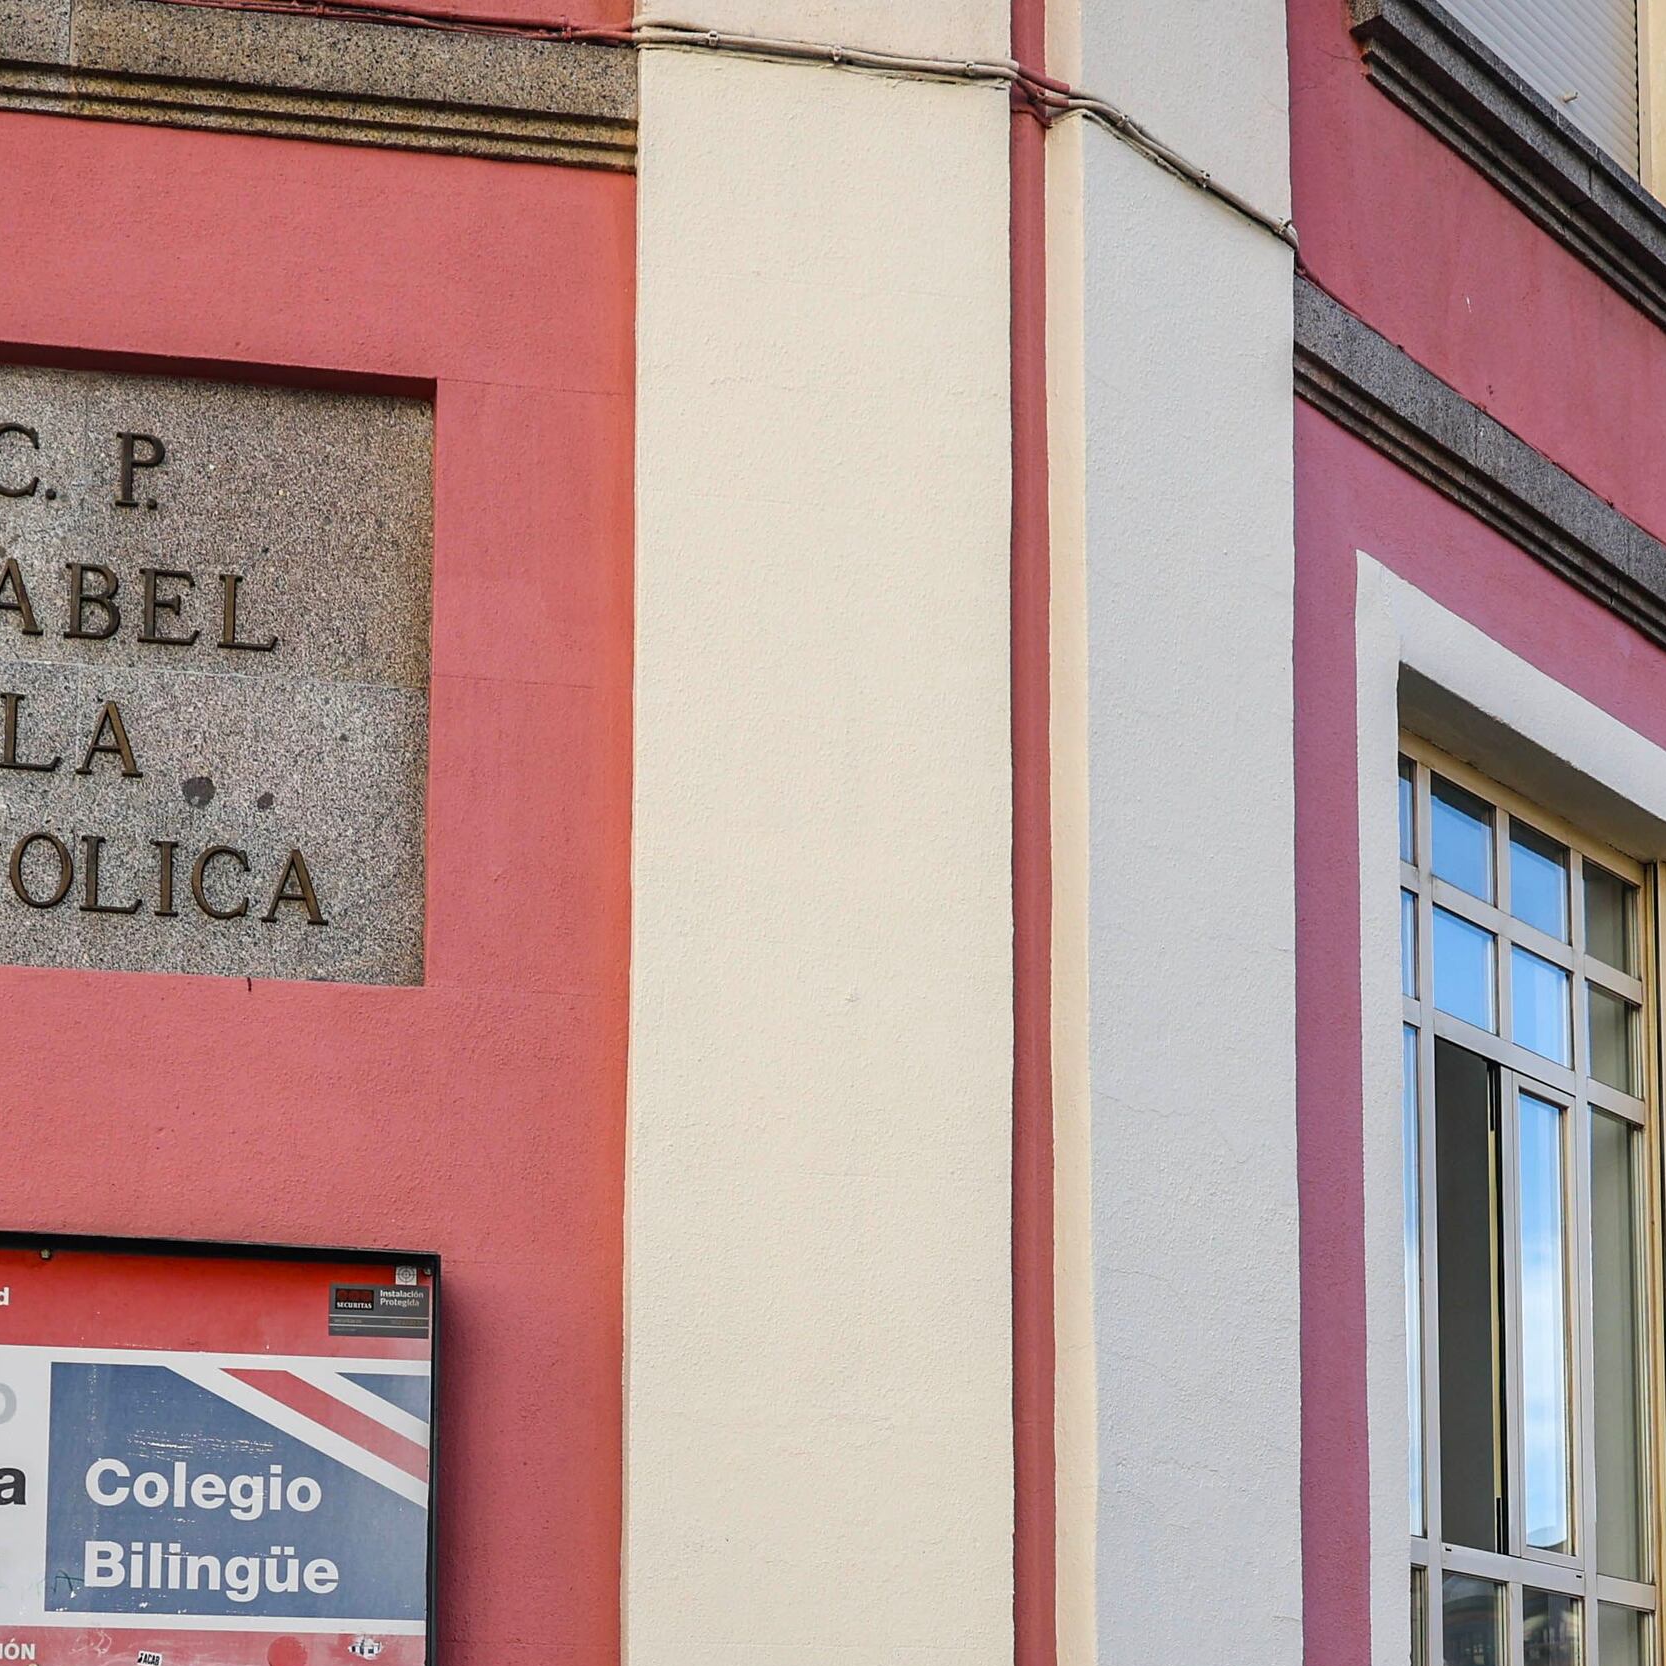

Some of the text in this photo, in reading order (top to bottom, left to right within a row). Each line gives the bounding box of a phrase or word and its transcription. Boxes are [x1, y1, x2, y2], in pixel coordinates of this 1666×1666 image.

[115, 431, 166, 509] P.
[336, 1301, 373, 1309] SECURITAS
[379, 1289, 424, 1299] Instalación
[379, 1298, 420, 1308] Protegida
[85, 1458, 322, 1521] Colegio
[84, 1540, 339, 1602] Bilingüe
